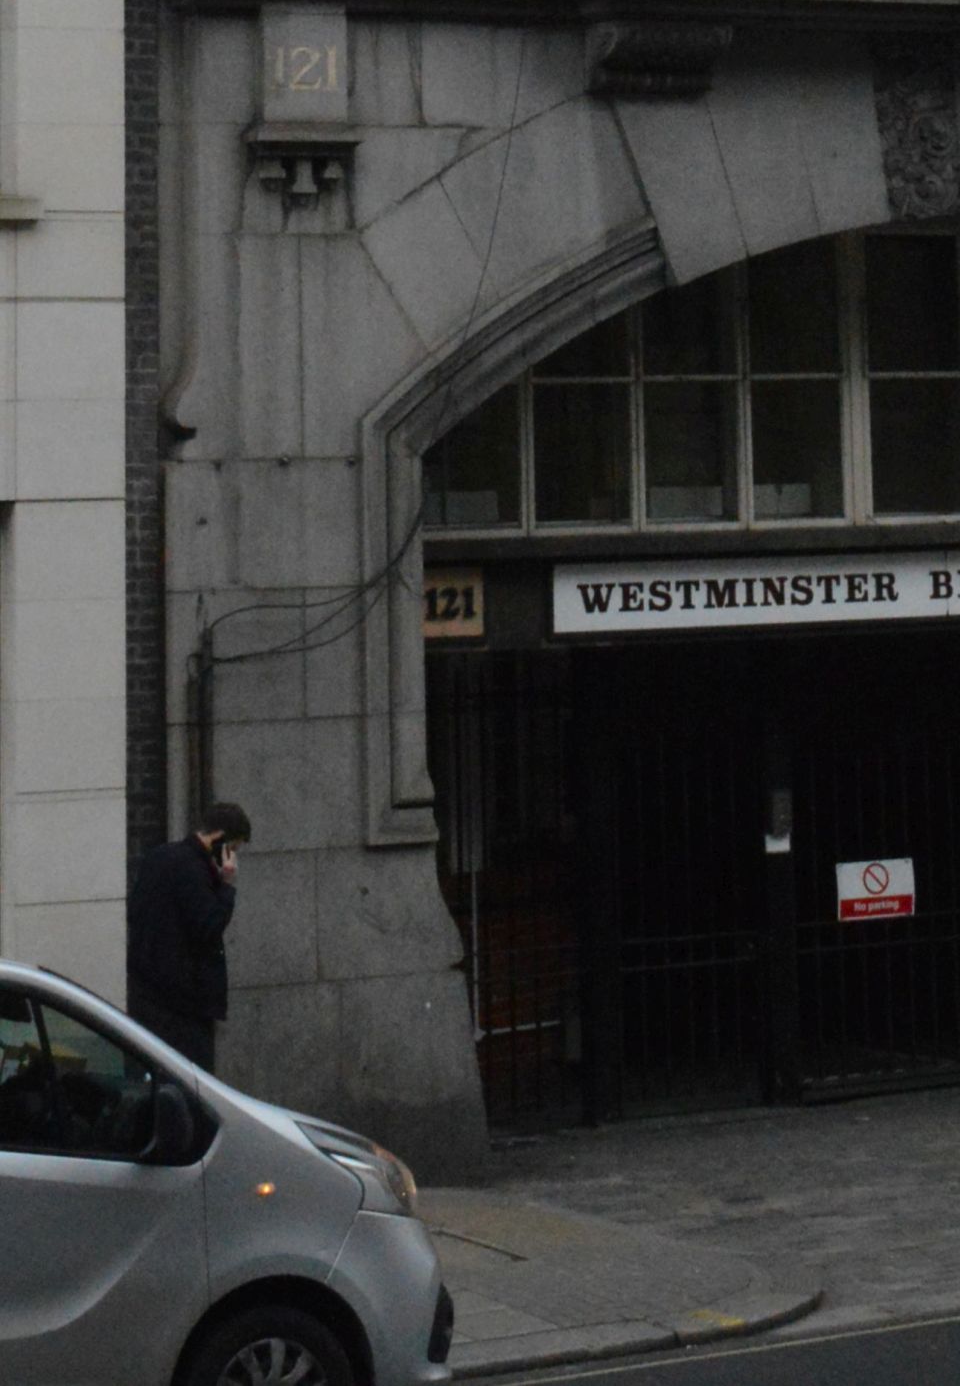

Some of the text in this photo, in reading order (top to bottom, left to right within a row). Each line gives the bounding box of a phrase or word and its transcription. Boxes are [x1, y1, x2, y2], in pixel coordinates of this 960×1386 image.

[271, 43, 339, 92] 121
[424, 585, 477, 622] 121
[576, 572, 900, 614] WESTMINSTER
[853, 900, 899, 913] No parking
